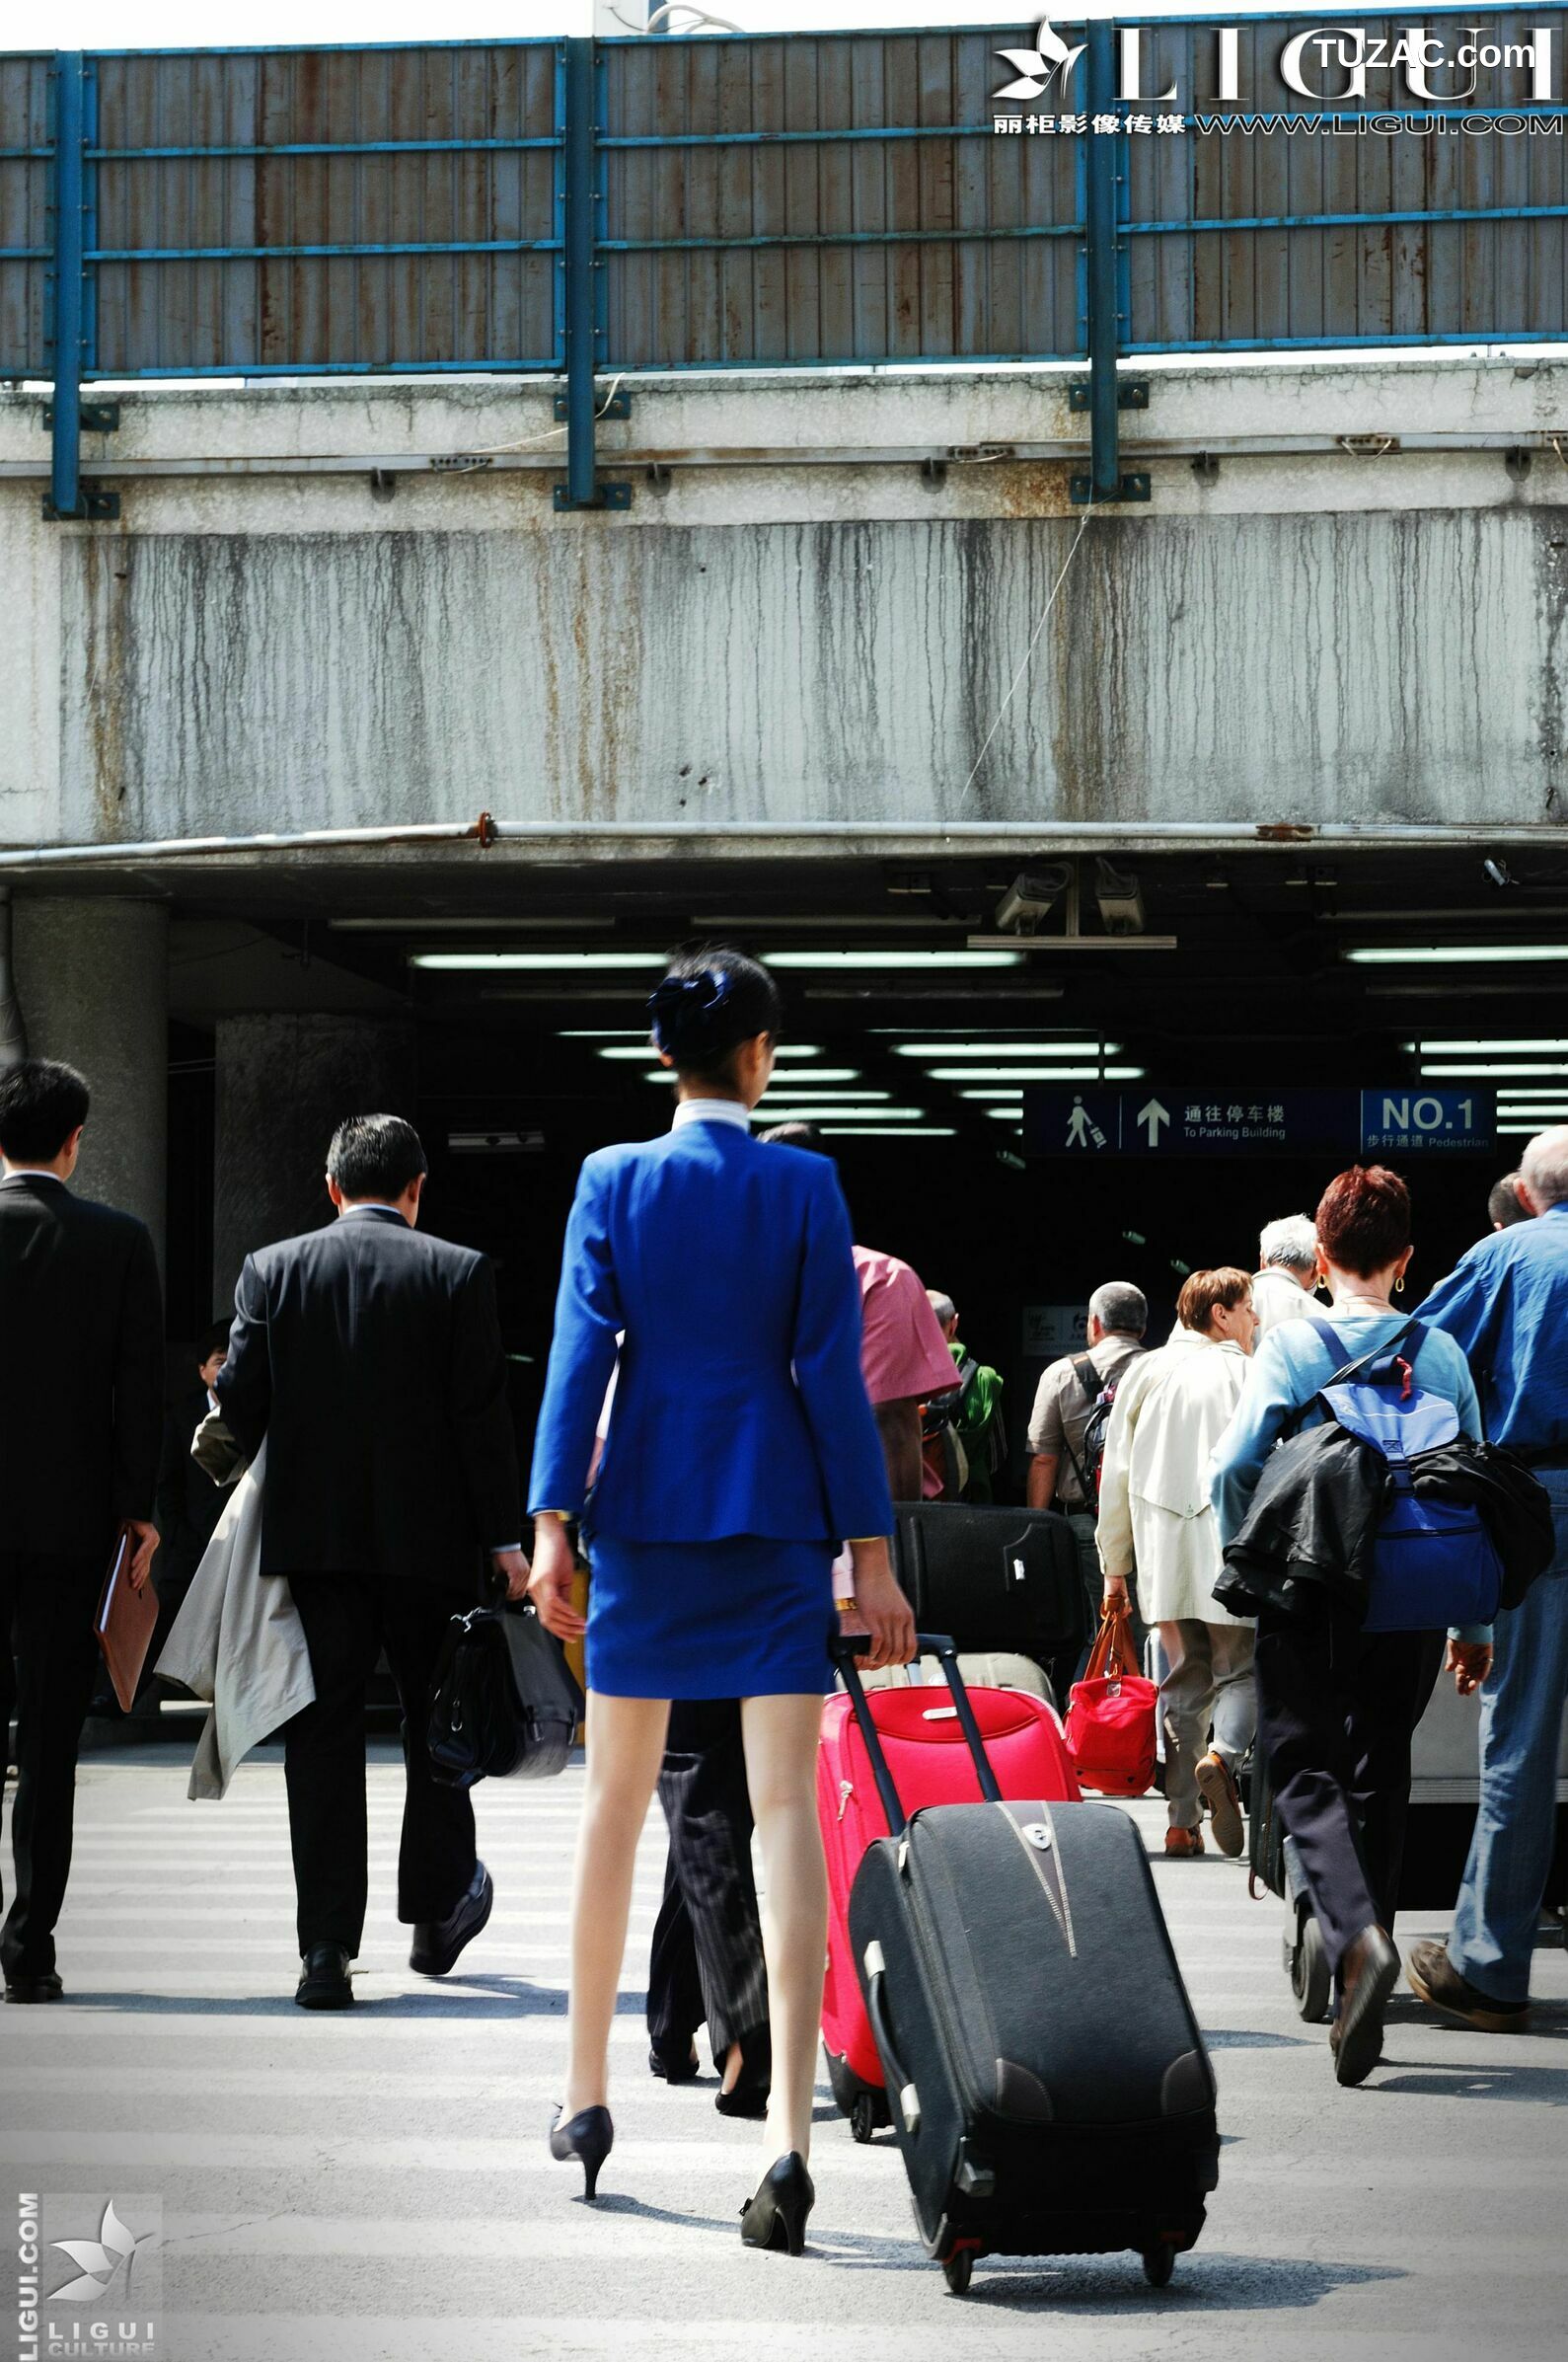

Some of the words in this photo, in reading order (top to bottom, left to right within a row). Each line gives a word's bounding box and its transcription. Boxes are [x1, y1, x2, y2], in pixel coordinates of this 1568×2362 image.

[1184, 1105, 1285, 1122] 通往停车楼
[1382, 1098, 1472, 1130] NO.1
[1184, 1127, 1197, 1138] To
[1199, 1127, 1239, 1140] Parking
[1241, 1127, 1286, 1140] Building
[1367, 1134, 1424, 1148] 步行通道
[1428, 1136, 1490, 1148] Pedestrian
